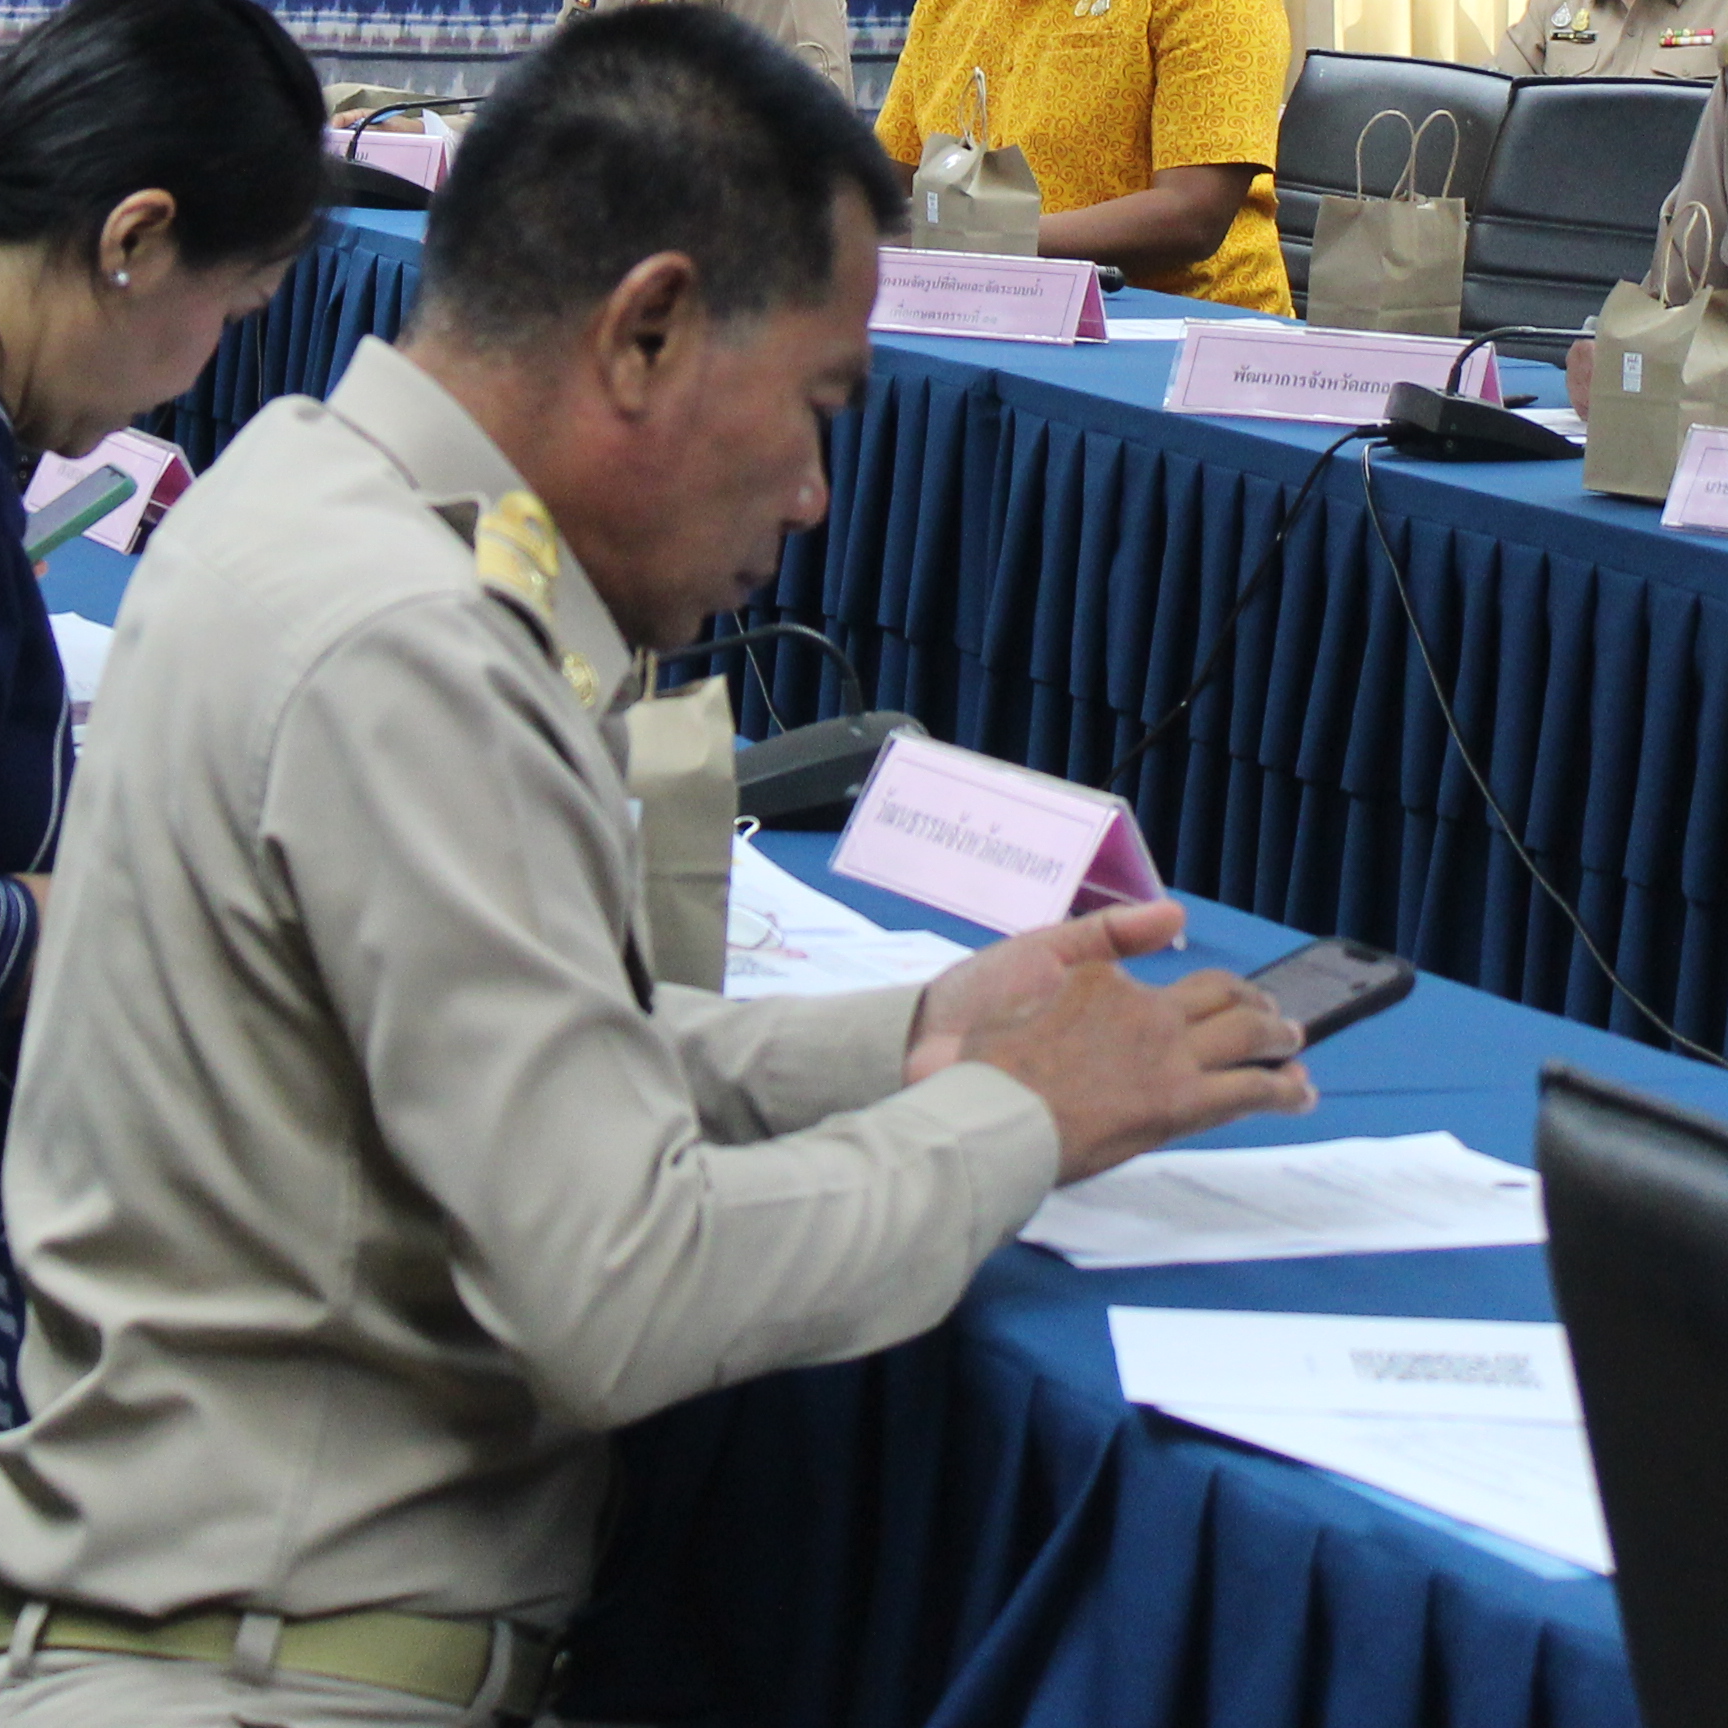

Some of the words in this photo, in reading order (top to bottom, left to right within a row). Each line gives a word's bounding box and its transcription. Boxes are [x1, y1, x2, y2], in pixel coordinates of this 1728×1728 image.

[1233, 364, 1391, 394] พัฒนาการจังหวัดสกล
